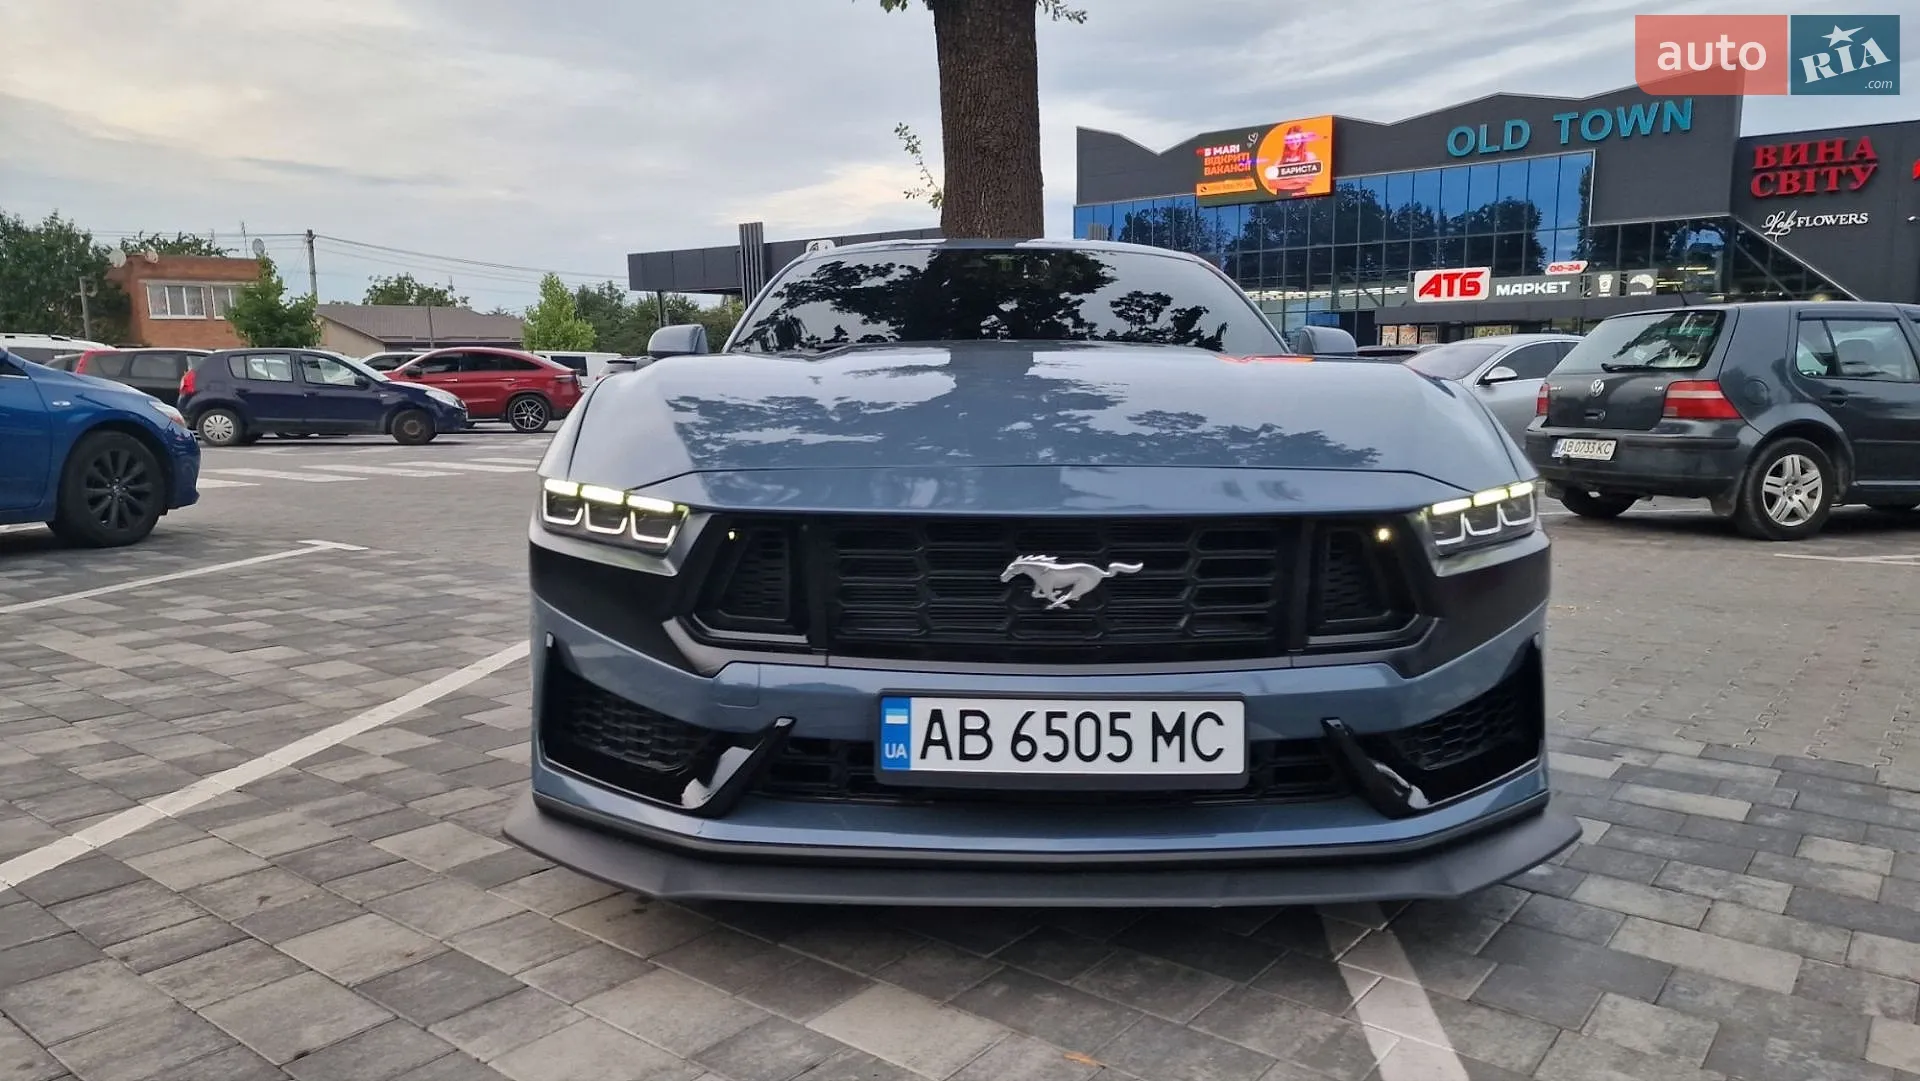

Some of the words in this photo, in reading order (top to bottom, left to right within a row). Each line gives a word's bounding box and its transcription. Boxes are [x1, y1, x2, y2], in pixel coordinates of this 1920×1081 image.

[1447, 119, 1531, 157] OLD
[1553, 98, 1693, 145] TOWN
[1752, 136, 1879, 169] ВИНА
[1280, 164, 1318, 176] БАРИСТА
[1751, 163, 1878, 198] СВІТУ
[1796, 212, 1869, 228] FLOWERS
[1550, 263, 1581, 272] 00-24
[1419, 271, 1485, 298] АТБ
[1496, 281, 1571, 296] МАРКЕТ
[1560, 440, 1574, 453] AB
[919, 708, 994, 762] AB
[1010, 710, 1133, 764] 6505
[1151, 711, 1225, 764] MC
[884, 743, 908, 759] UA
